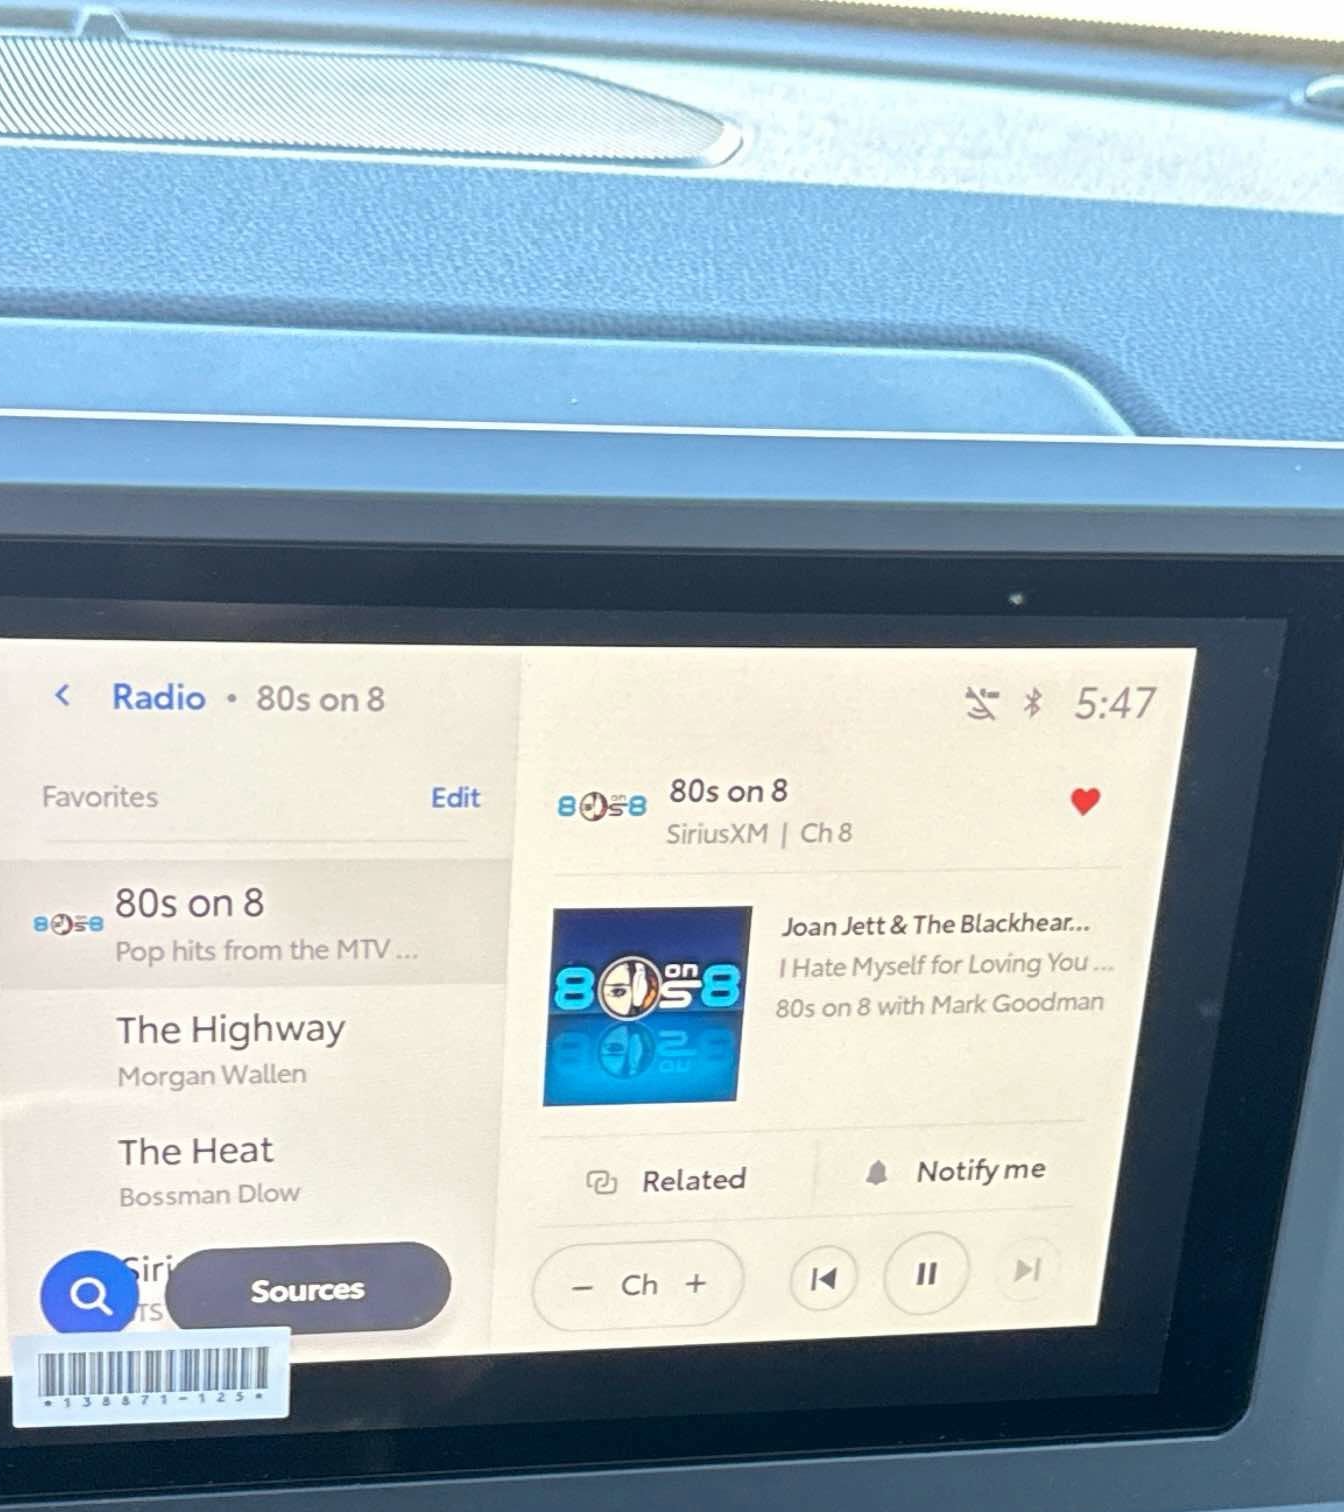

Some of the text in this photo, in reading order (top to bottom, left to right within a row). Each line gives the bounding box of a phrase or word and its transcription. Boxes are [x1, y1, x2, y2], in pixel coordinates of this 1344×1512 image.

[113, 683, 206, 712] Radio
[257, 686, 385, 713] 80s on 8
[1075, 686, 1156, 719] 5:47
[42, 784, 159, 809] Favorites
[431, 786, 482, 809] Edit
[669, 778, 788, 804] 80s on 8
[666, 821, 854, 846] SiriusXM Ch 8
[115, 888, 265, 918] 80s on 8
[781, 915, 838, 937] Joan
[840, 914, 886, 936] Jett
[889, 915, 908, 935] &
[913, 913, 956, 934] The
[116, 940, 166, 968] Pop
[173, 938, 216, 962] hits
[225, 938, 282, 961] from
[290, 937, 330, 961] the
[338, 938, 391, 960] MTV
[792, 957, 846, 978] Hate
[853, 954, 923, 982] Myself
[928, 954, 961, 974] for
[969, 953, 1042, 979] Loving
[1047, 953, 1090, 973] You
[775, 991, 1104, 1018] 80s on 8 with Mark Goodman
[117, 1013, 347, 1050] The Highway
[118, 1063, 307, 1094] Morgan Wallen
[118, 1136, 274, 1168] The Heat
[642, 1167, 747, 1194] Related
[917, 1159, 1046, 1188] Notify me
[119, 1182, 302, 1208] Bossman Dlow
[251, 1278, 366, 1305] Sources
[621, 1273, 658, 1296] Ch
